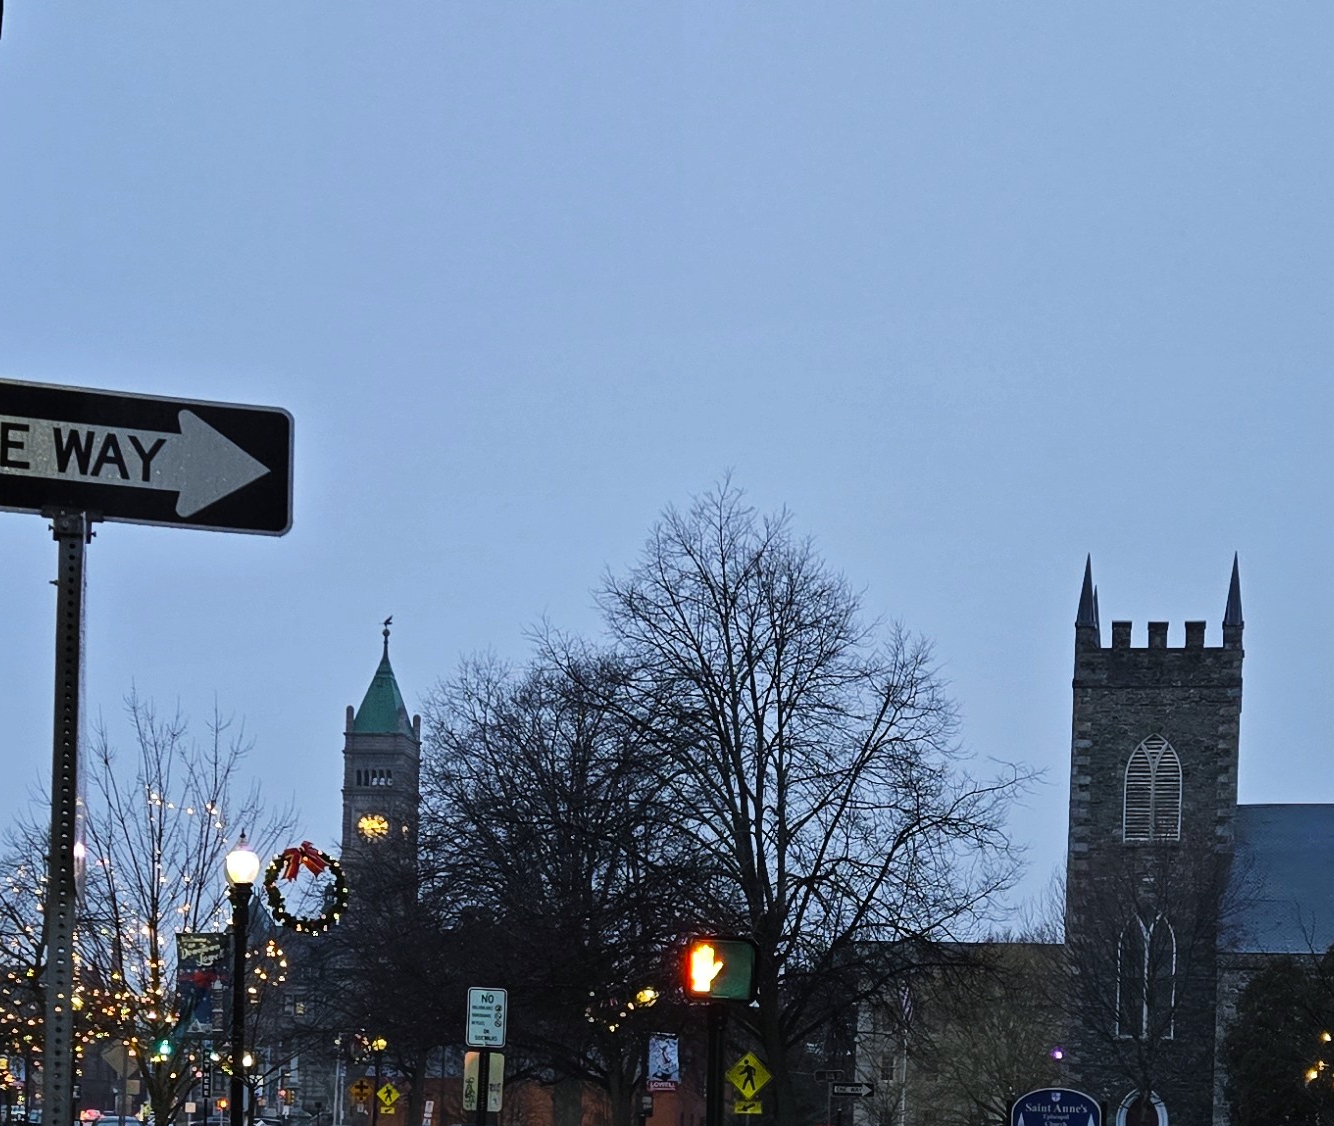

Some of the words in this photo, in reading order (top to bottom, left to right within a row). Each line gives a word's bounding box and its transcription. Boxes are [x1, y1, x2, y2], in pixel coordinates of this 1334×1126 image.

[53, 427, 167, 483] WAY
[481, 994, 495, 1004] NO
[1025, 1103, 1051, 1112] Saint
[1053, 1104, 1087, 1113] Anne's
